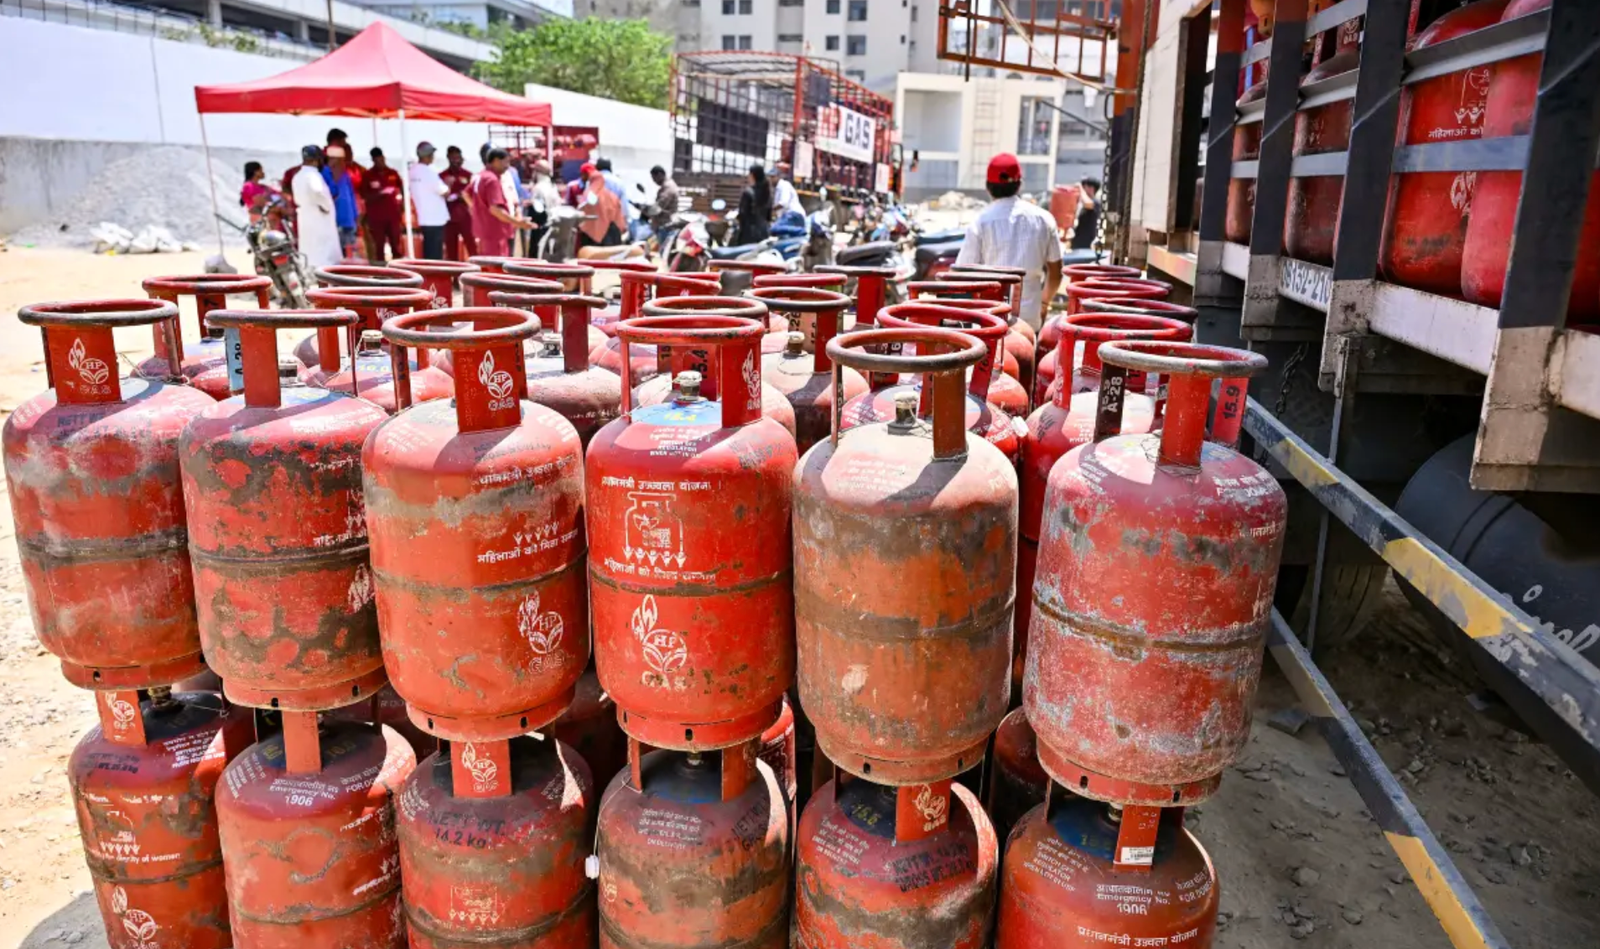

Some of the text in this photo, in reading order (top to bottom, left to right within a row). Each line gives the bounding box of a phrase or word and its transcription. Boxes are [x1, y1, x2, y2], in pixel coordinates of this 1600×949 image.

[844, 112, 871, 151] GAS
[85, 361, 103, 370] HP
[494, 373, 507, 383] HP
[1222, 384, 1241, 420] 15.9
[653, 632, 678, 648] HP
[270, 785, 336, 800] Emergency No.
[285, 794, 314, 807] 1906
[1155, 896, 1171, 905] No.
